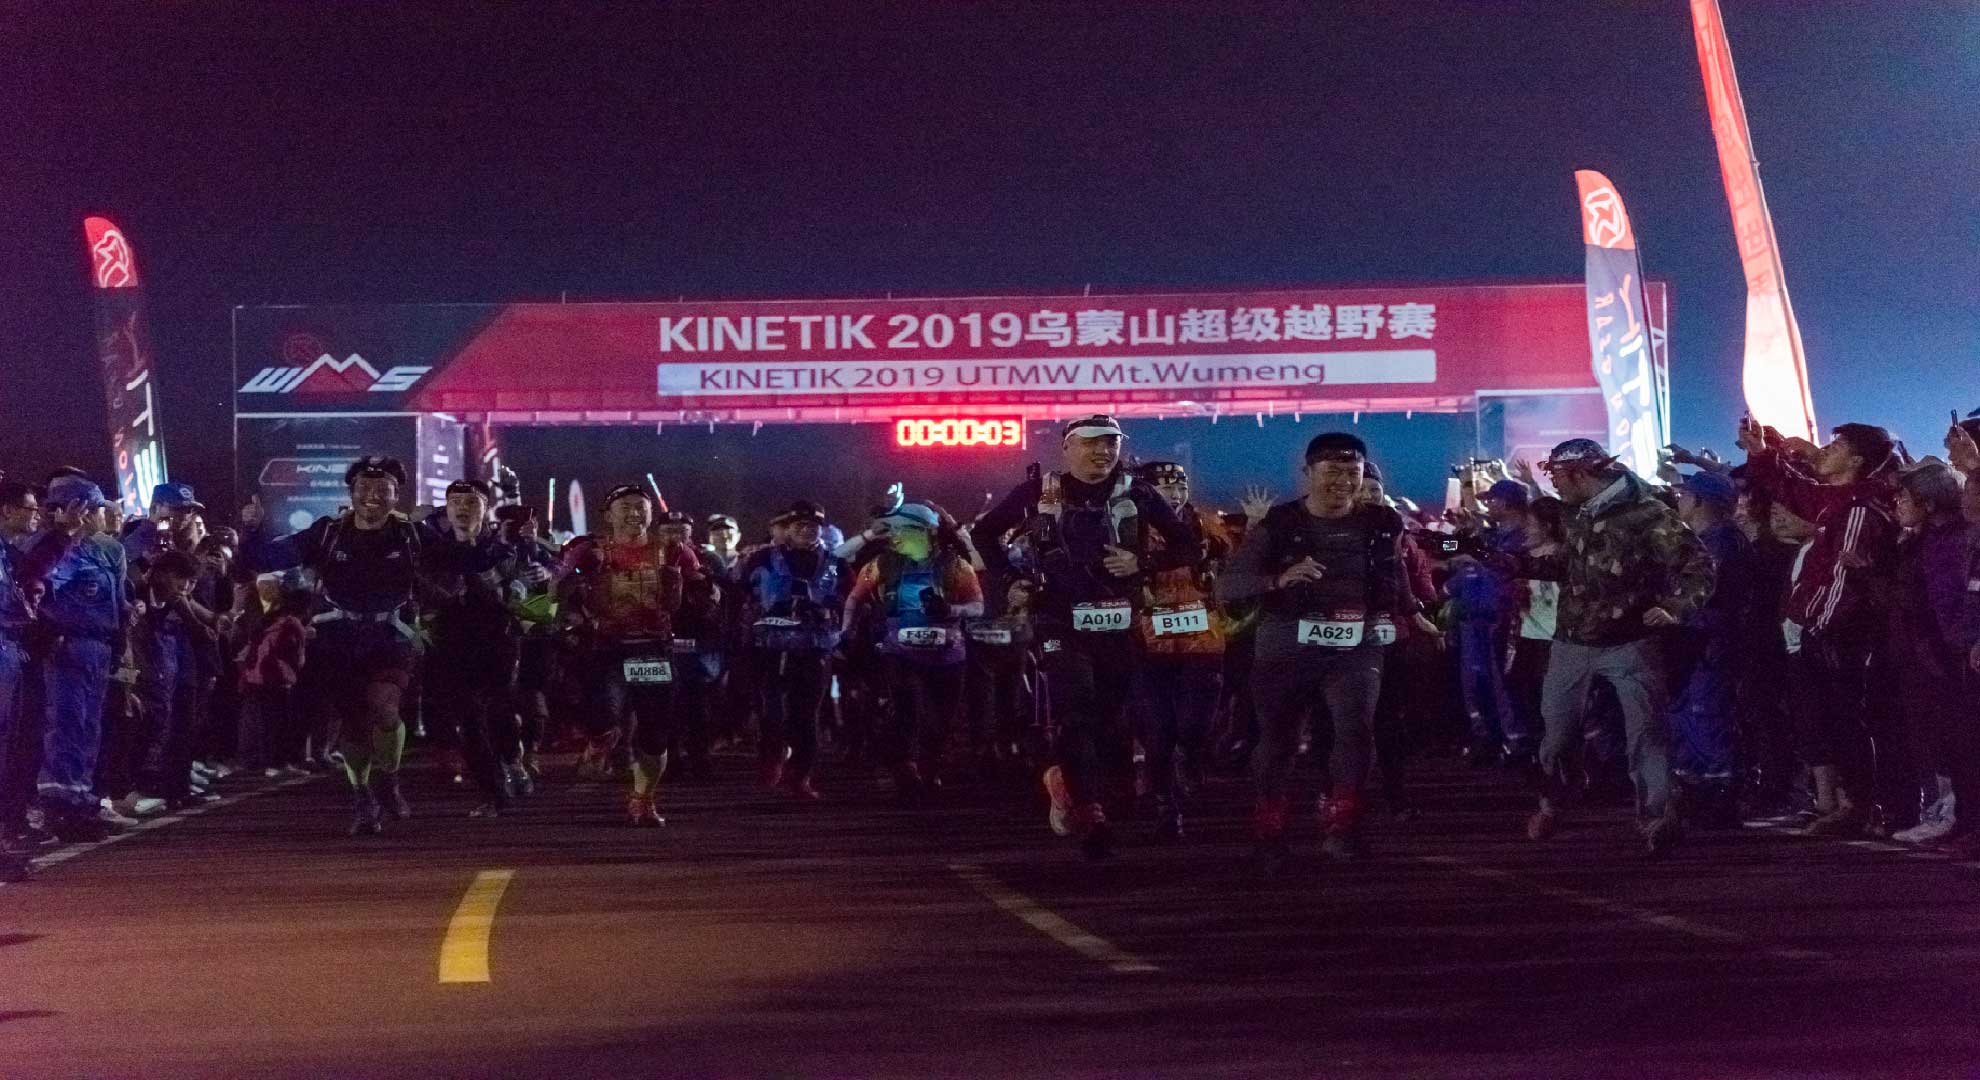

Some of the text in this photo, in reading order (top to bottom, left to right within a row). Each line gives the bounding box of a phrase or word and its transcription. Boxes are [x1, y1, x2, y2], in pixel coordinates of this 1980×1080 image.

[659, 315, 876, 352] KINETIK
[700, 361, 1326, 390] KINETIK 2019 UTMW Mt.Wumeng
[896, 418, 1021, 447] 00:00:03
[1081, 612, 1122, 626] A010
[1162, 615, 1200, 629] B111
[1307, 624, 1354, 640] A629
